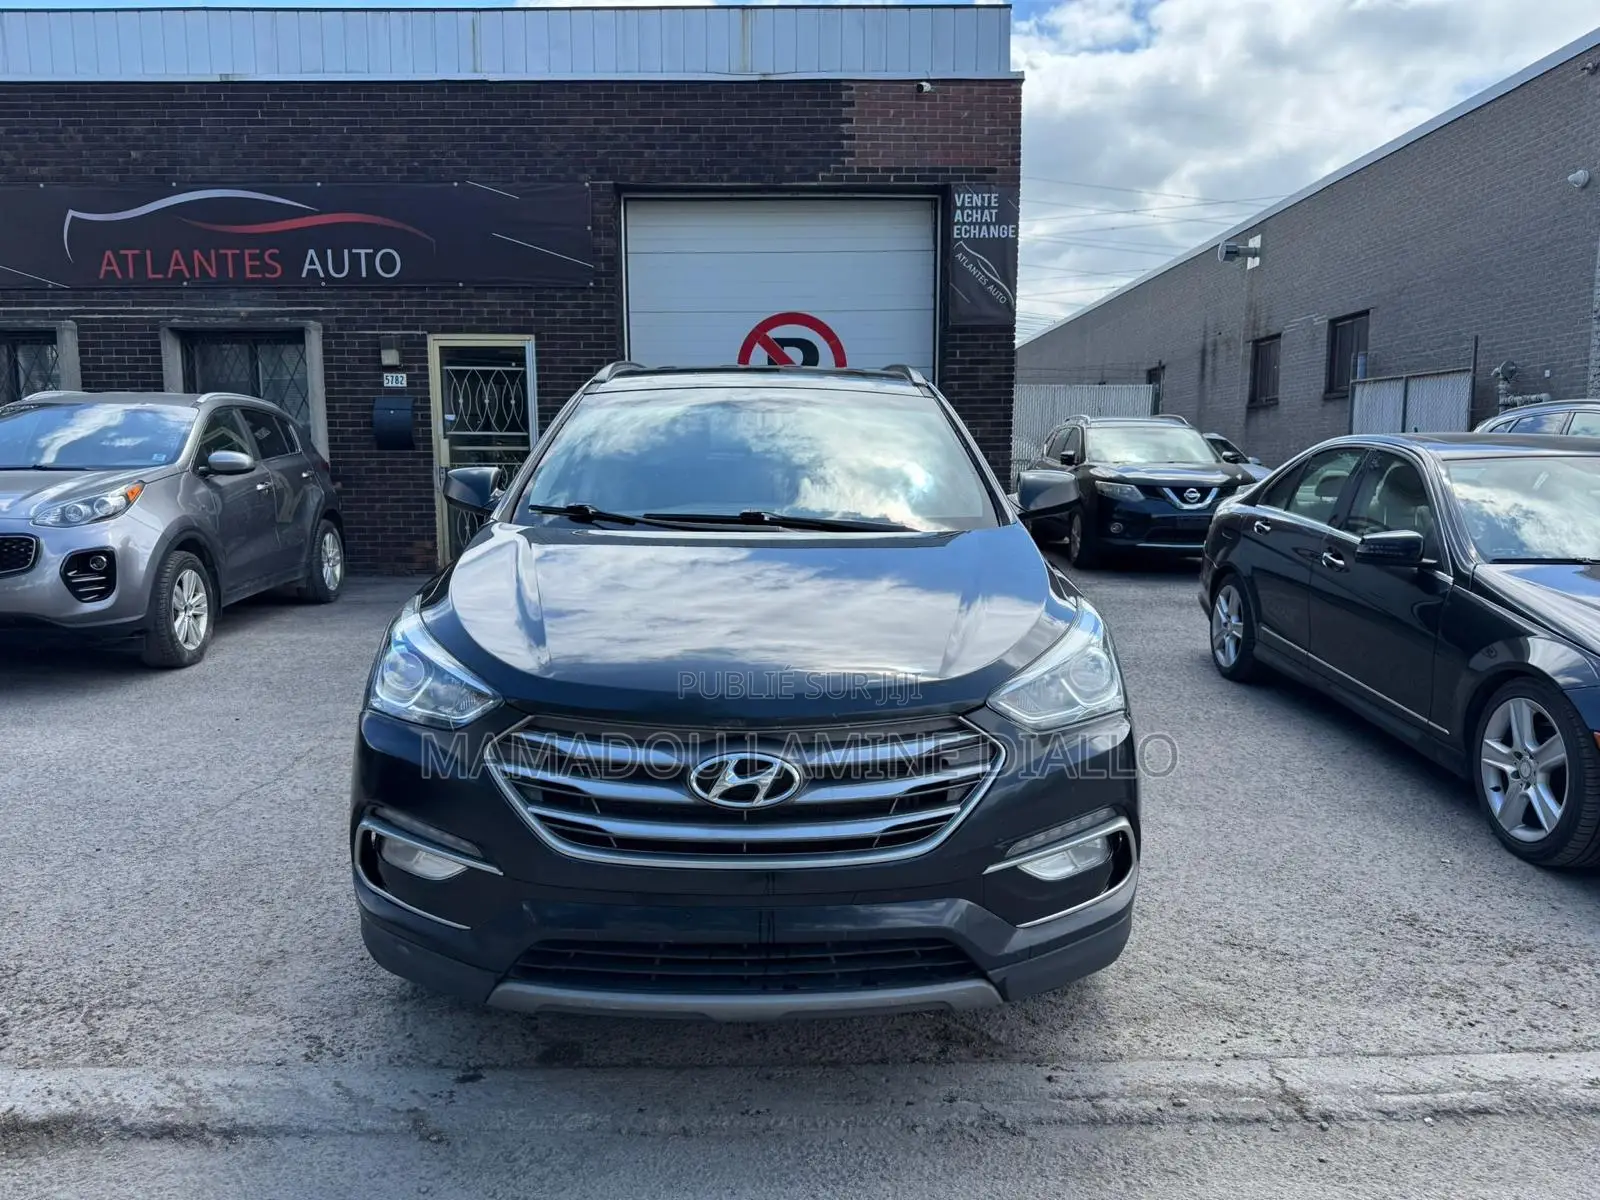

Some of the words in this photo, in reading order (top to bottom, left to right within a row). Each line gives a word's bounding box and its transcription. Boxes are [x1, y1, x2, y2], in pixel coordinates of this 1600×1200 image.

[954, 193, 999, 207] VENTE
[954, 209, 998, 222] ACHAT
[953, 225, 1016, 238] ECHANGE
[99, 248, 282, 279] ATLANTES
[301, 248, 401, 279] AUTO
[955, 252, 989, 286] ATLANTES
[987, 284, 1007, 304] AUTO
[385, 375, 404, 385] 5782
